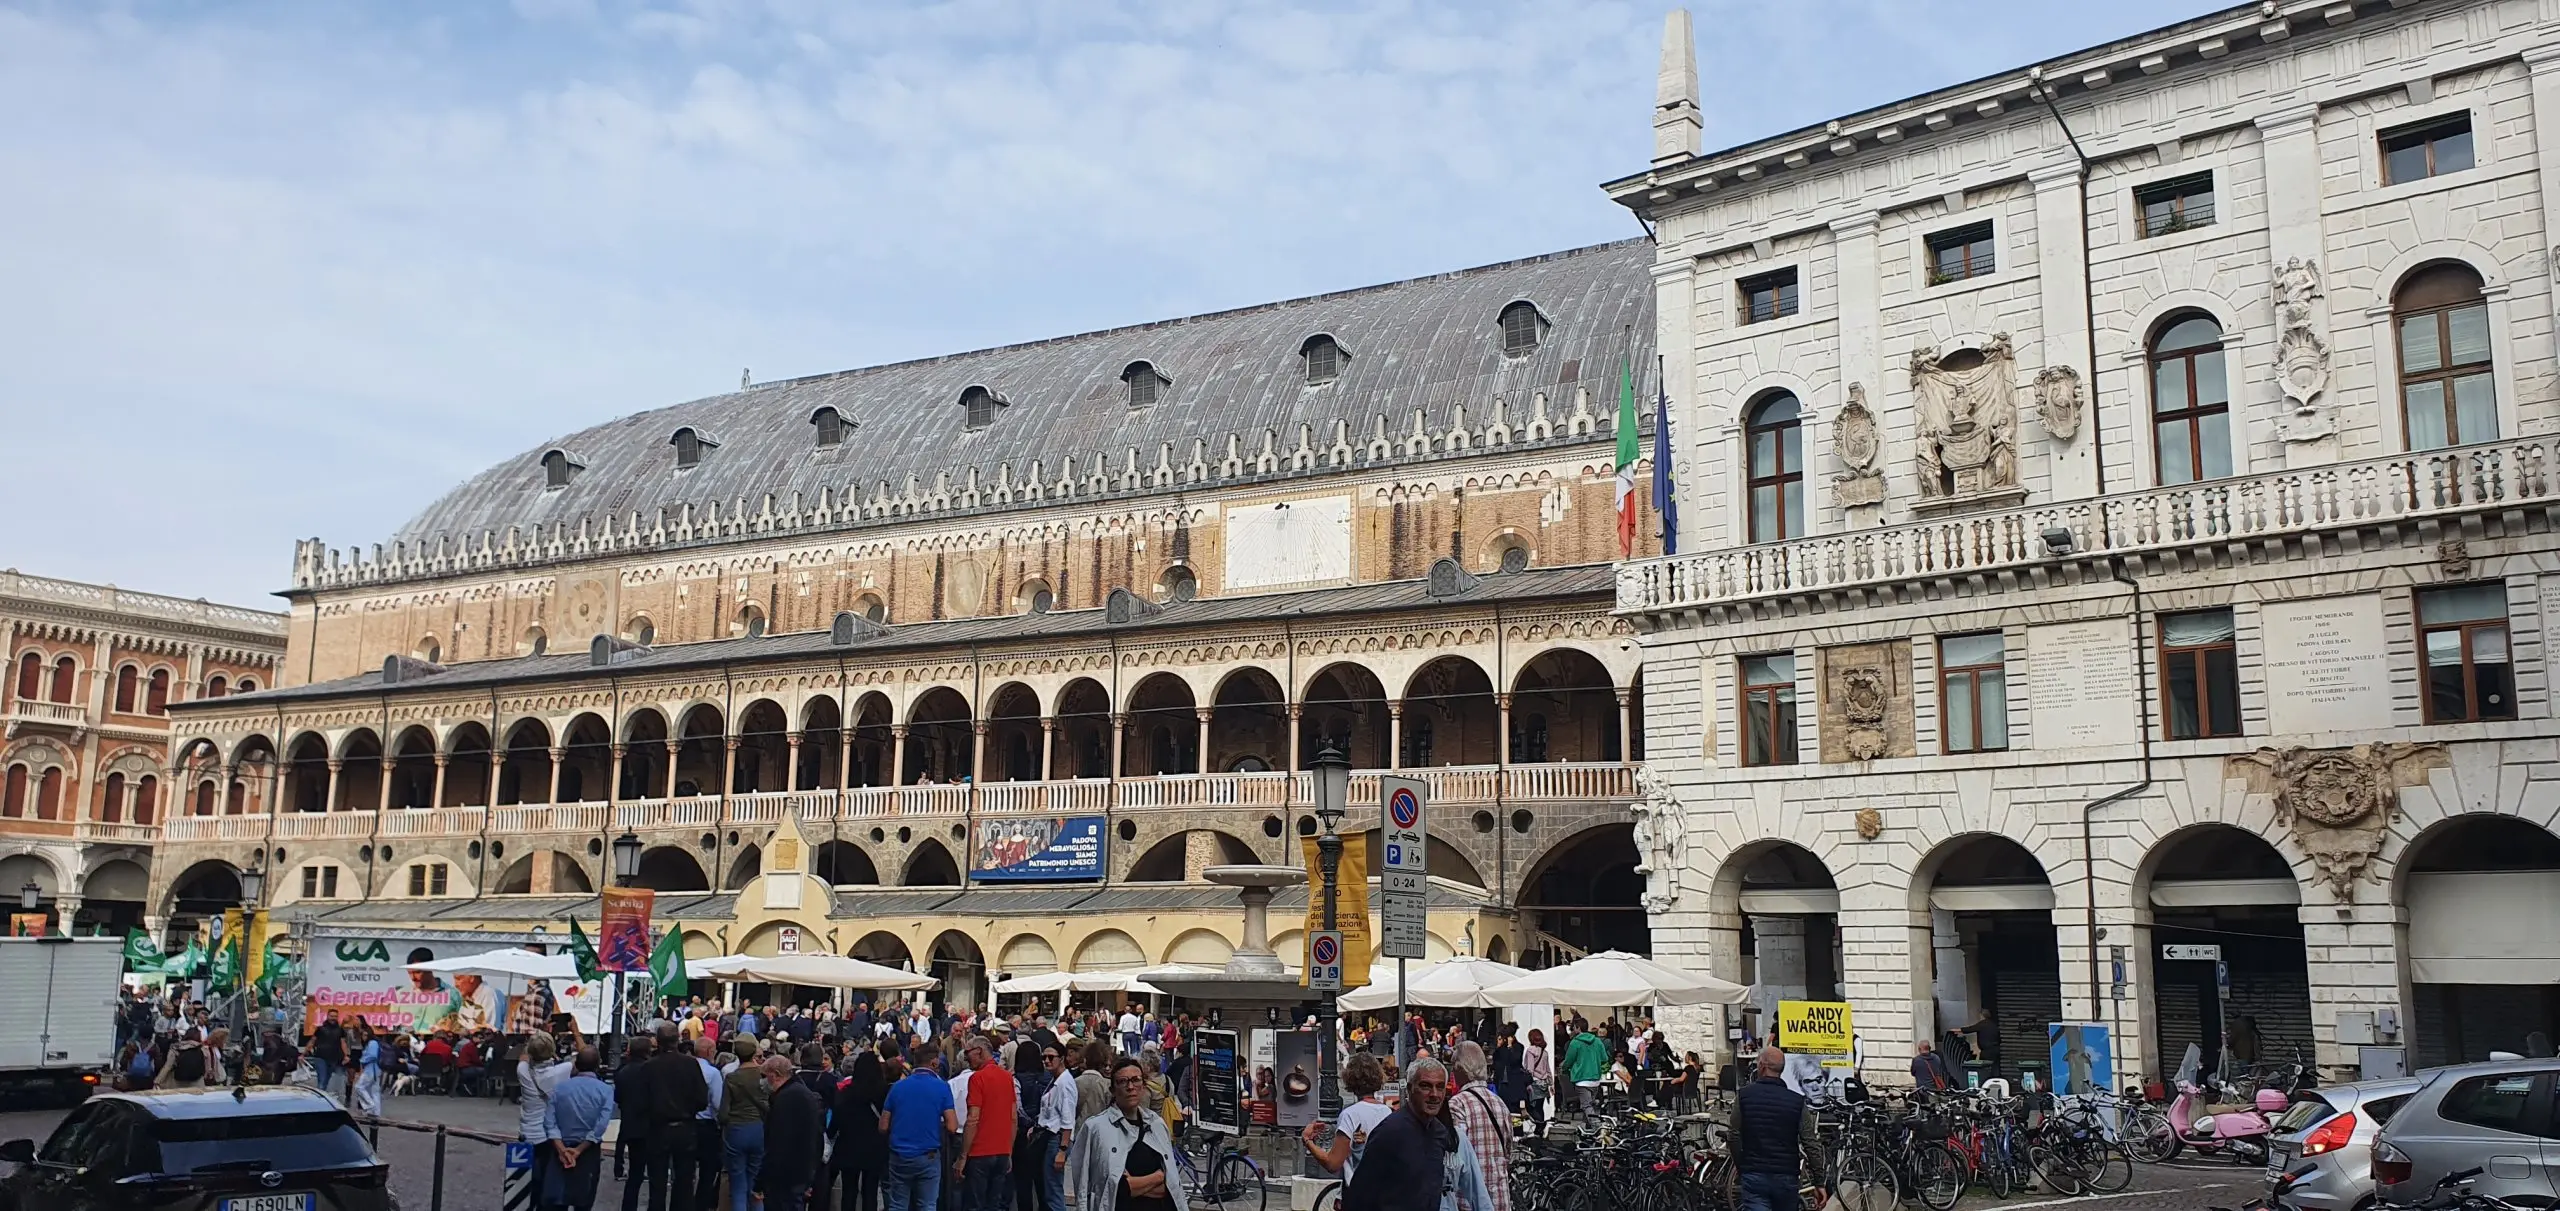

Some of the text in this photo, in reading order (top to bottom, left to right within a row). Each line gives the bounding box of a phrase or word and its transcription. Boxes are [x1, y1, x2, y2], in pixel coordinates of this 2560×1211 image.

[1389, 847, 1398, 861] P
[1069, 858, 1097, 866] UNESCO
[1393, 877, 1399, 887] 0
[1314, 888, 1342, 899] galo
[1335, 911, 1360, 919] cienza
[1317, 920, 1362, 928] invazione
[1313, 967, 1320, 977] P
[341, 973, 381, 982] VENETO
[315, 986, 450, 1006] GenerAzioni
[1807, 1007, 1844, 1020] ANDY
[1786, 1020, 1846, 1034] WARHOL
